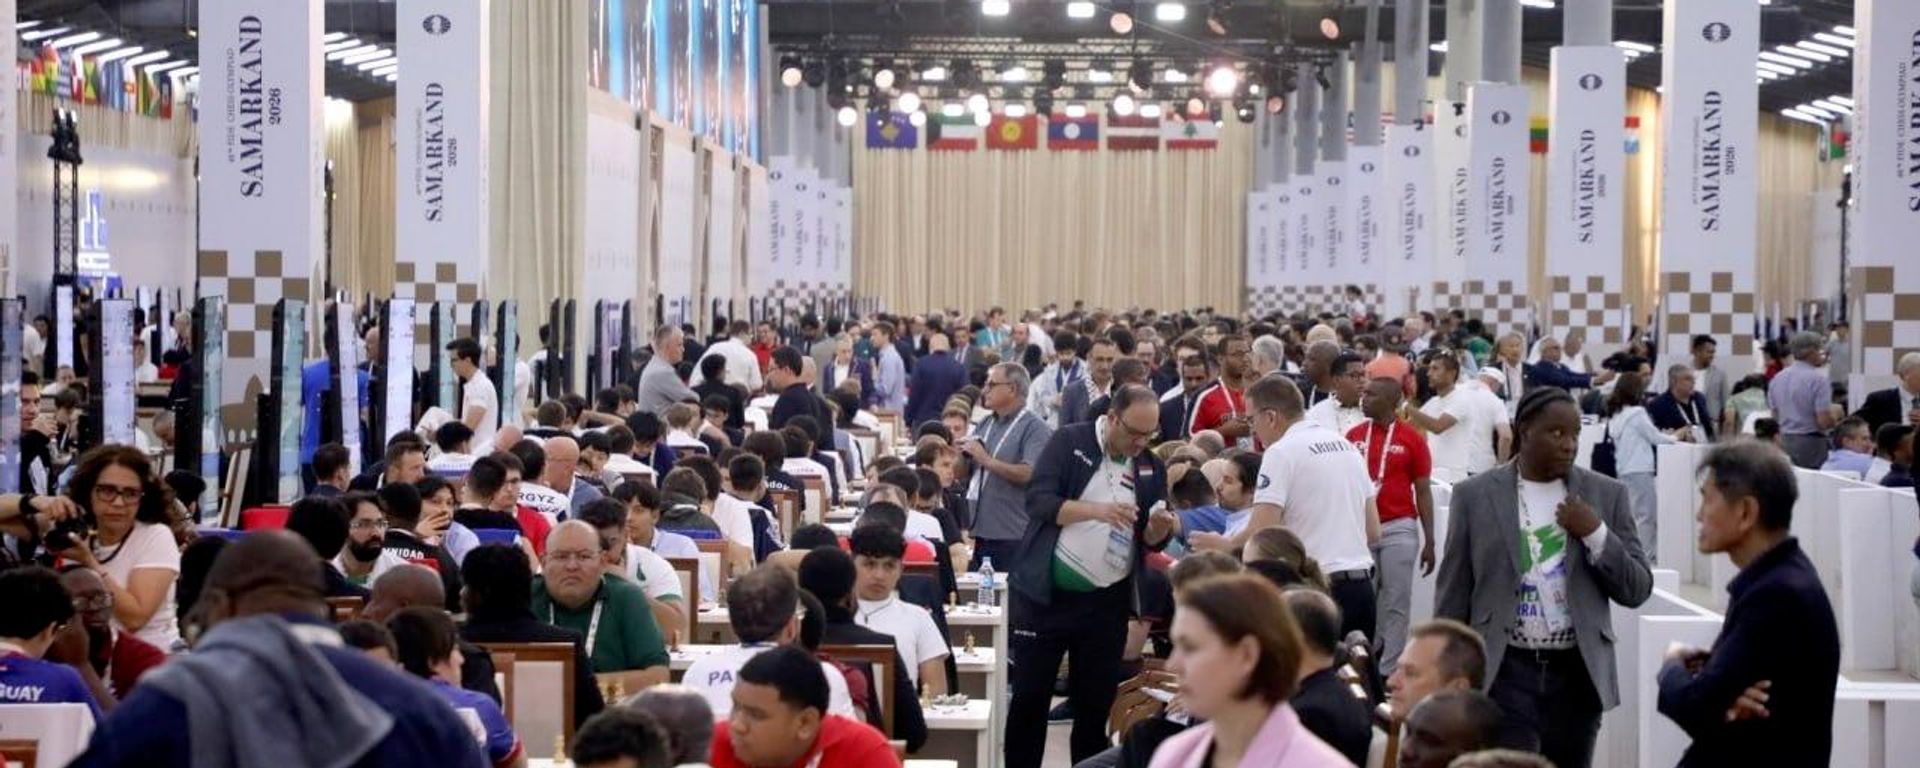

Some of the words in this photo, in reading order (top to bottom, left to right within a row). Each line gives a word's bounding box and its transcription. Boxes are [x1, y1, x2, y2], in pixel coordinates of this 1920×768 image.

[239, 15, 264, 197] SAMARKAND
[268, 88, 282, 125] 2026
[425, 82, 444, 222] SAMARKAND
[1456, 167, 1468, 256] SAMARKAND
[1491, 157, 1505, 254] SAMARKAND
[1579, 129, 1596, 244] SAMARKAND
[1702, 90, 1721, 231] SAMARKAND
[708, 669, 733, 687] PA
